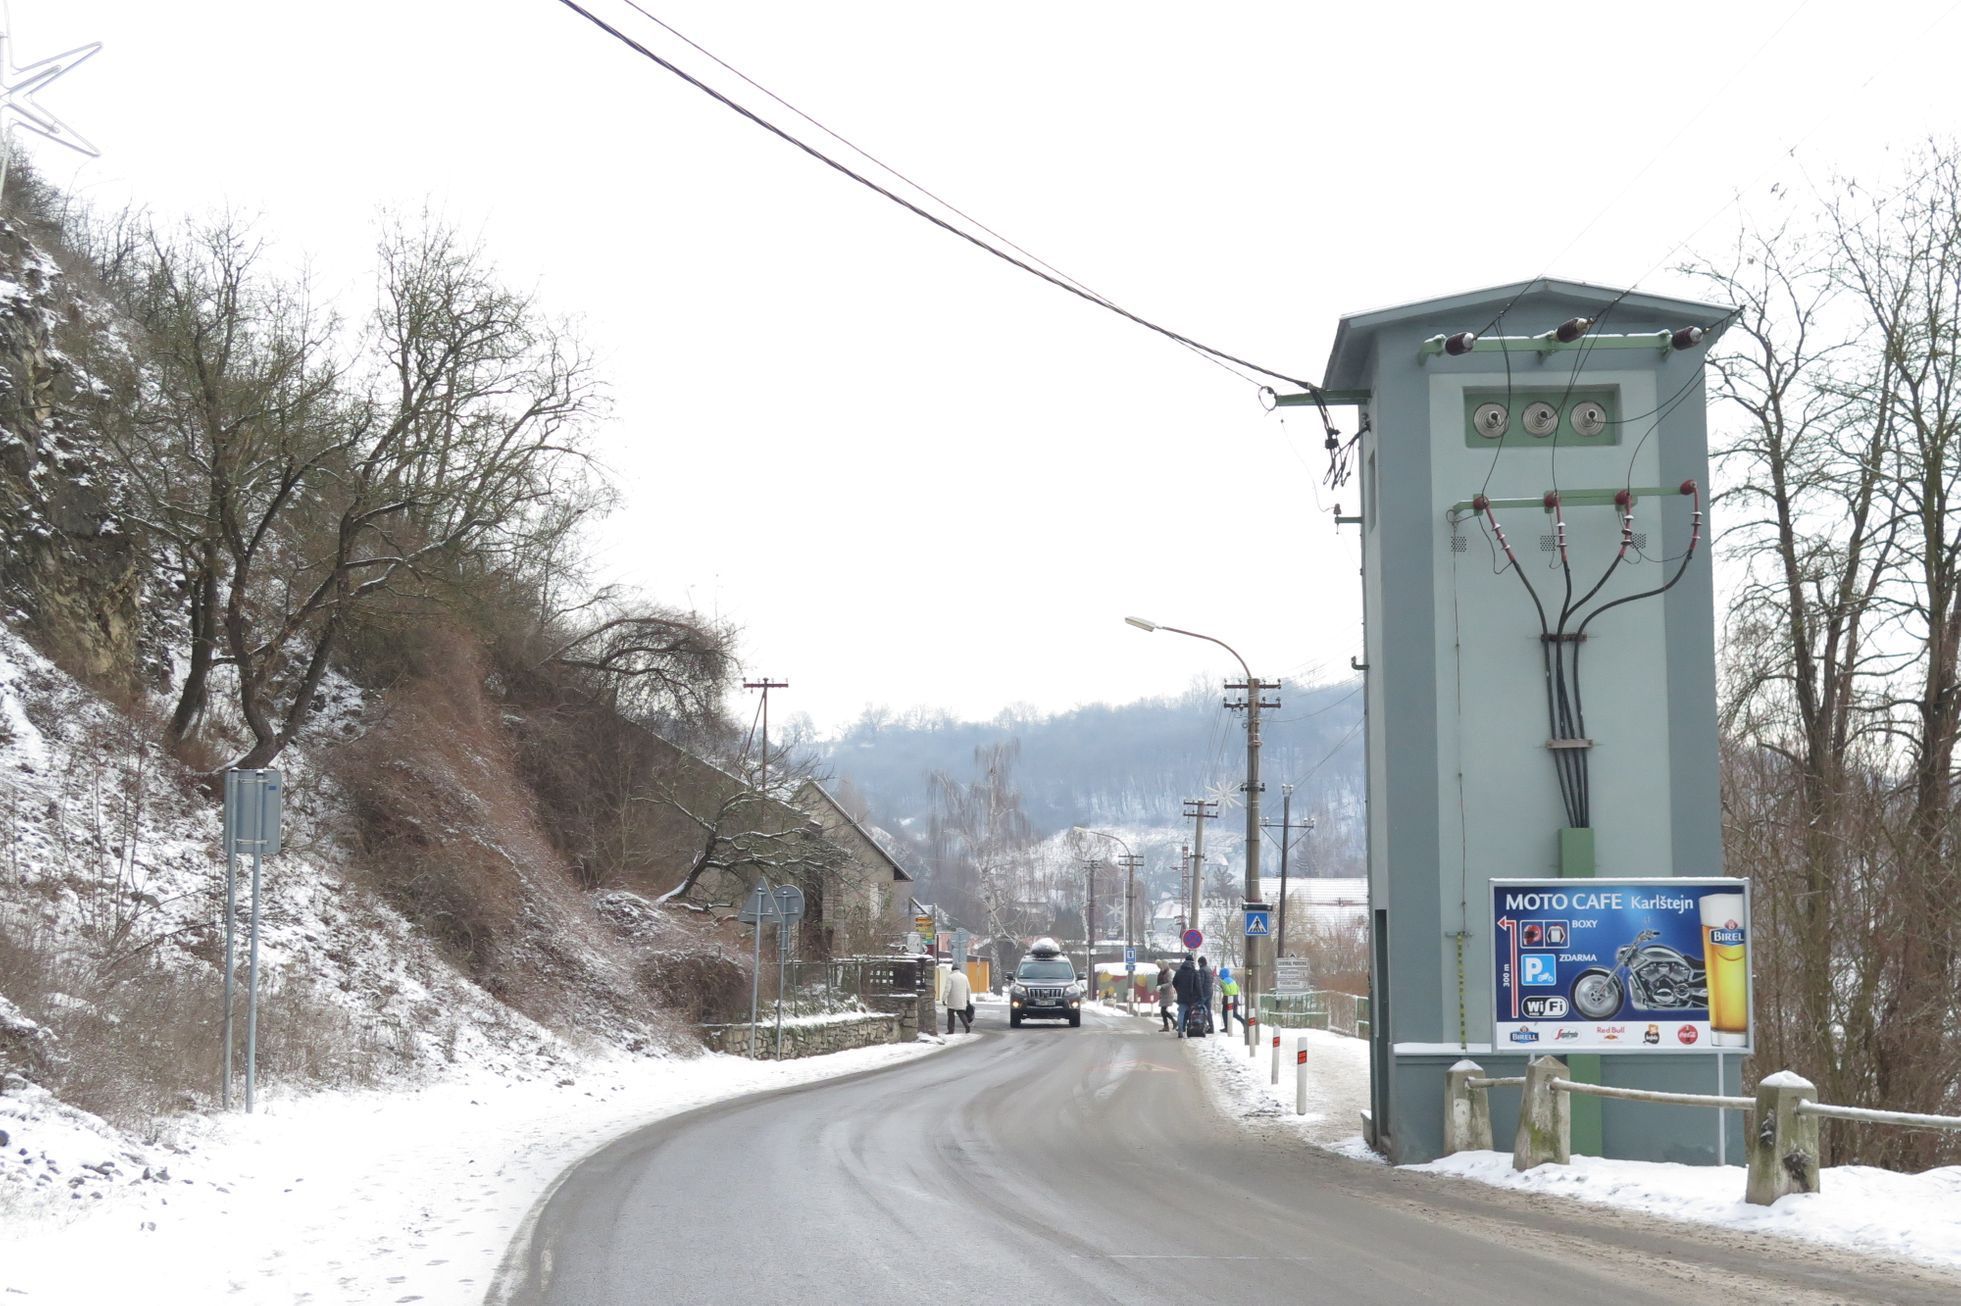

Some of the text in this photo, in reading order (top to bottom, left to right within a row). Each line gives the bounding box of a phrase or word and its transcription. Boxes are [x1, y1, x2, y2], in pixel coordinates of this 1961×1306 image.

[1506, 893, 1694, 914] MOTO CAFE Karlštejn
[1572, 919, 1598, 928] BOXY
[1559, 954, 1597, 962] ZDARMA
[1504, 963, 1510, 972] m
[1525, 957, 1543, 982] P
[1512, 1032, 1537, 1040] BIRELL
